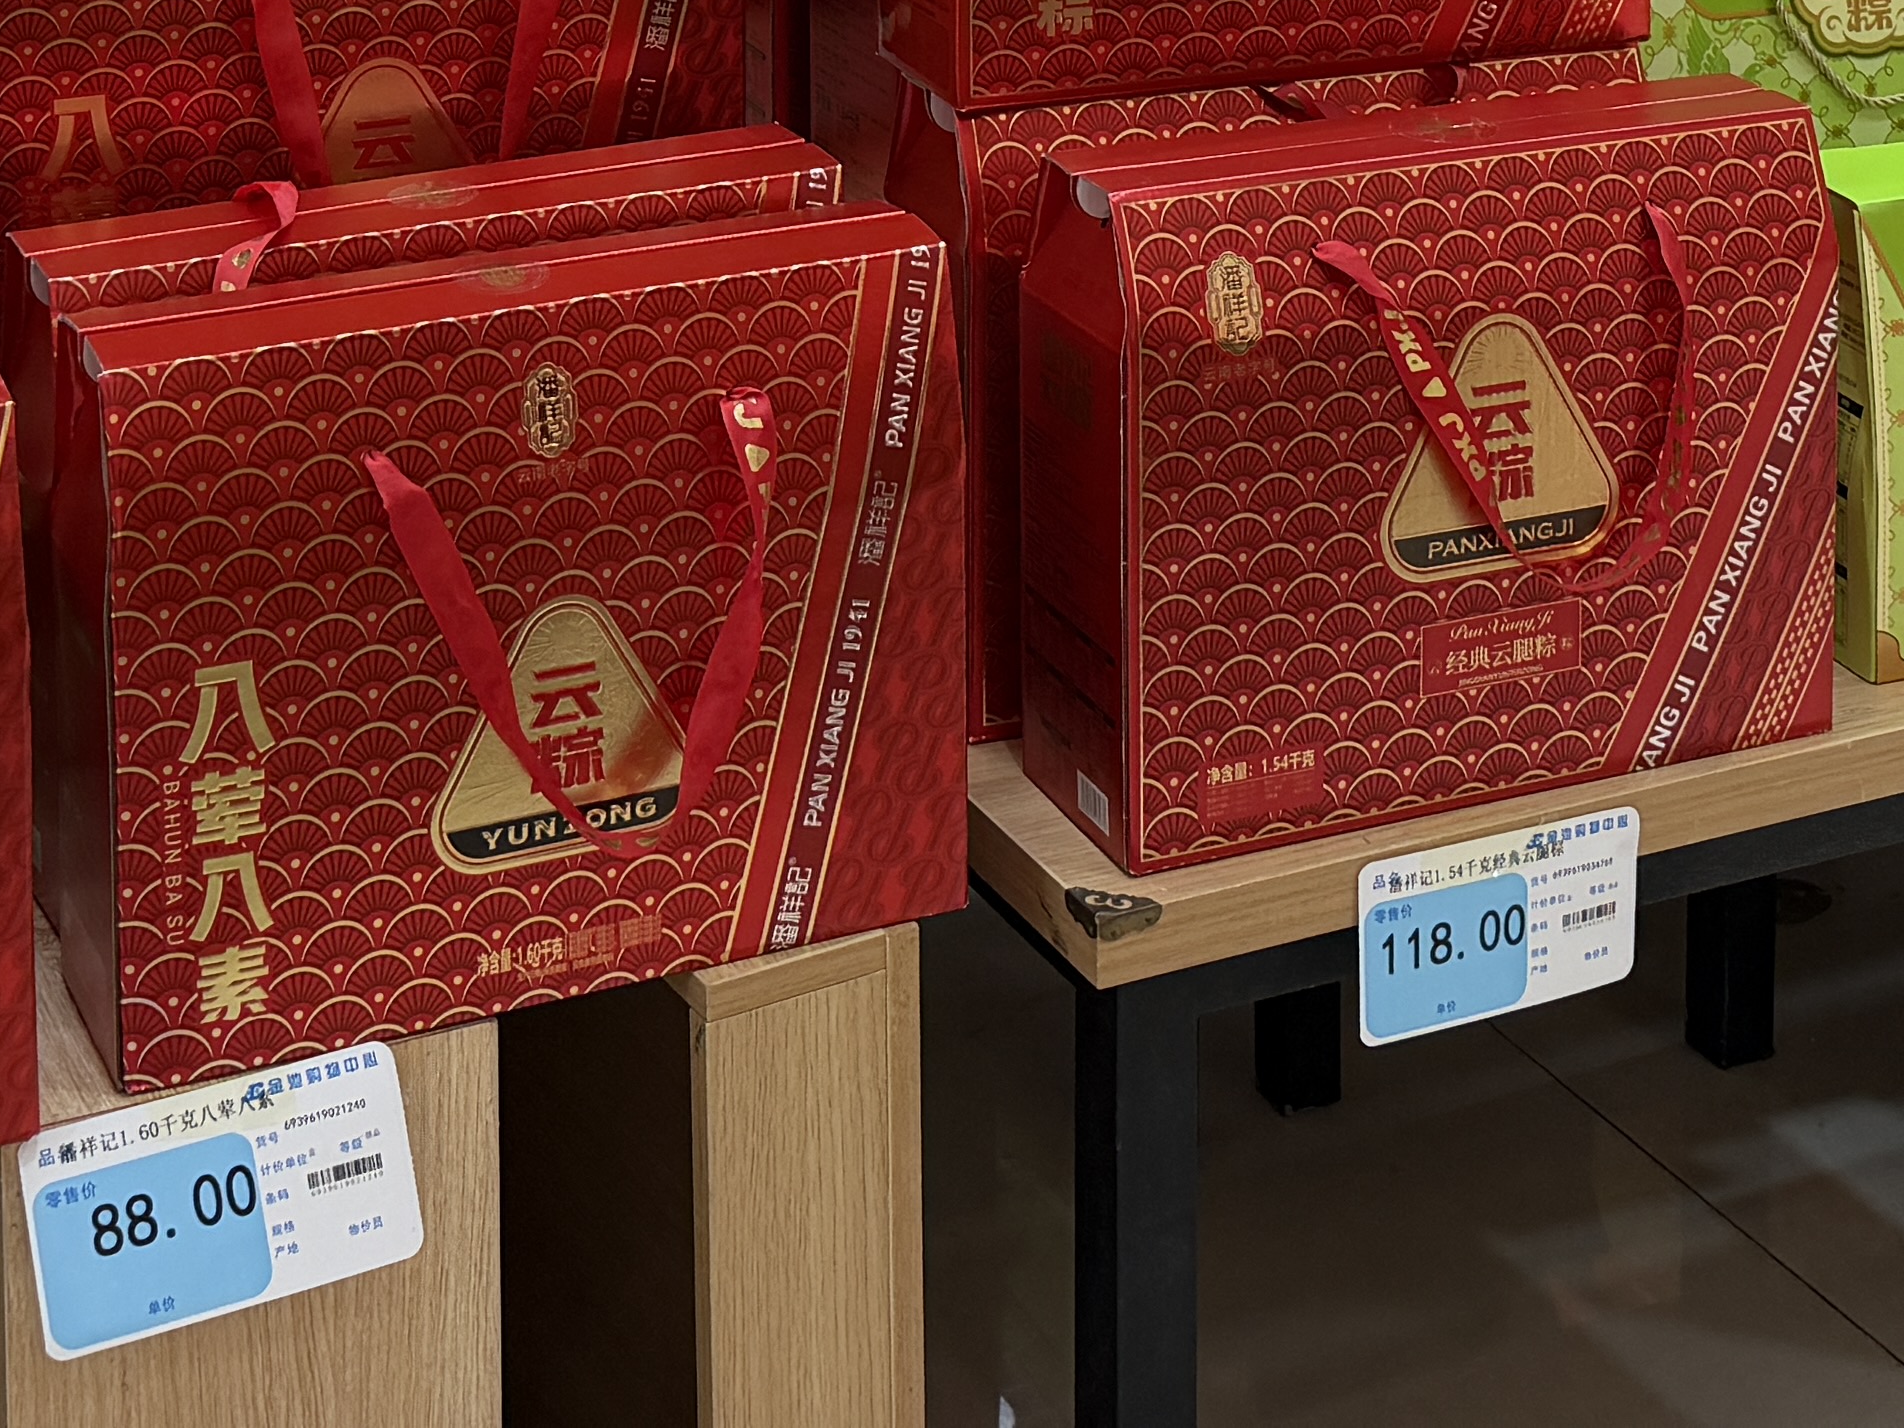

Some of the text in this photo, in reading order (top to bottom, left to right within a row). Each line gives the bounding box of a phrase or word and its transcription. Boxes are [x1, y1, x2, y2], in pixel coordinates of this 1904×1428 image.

[1693, 463, 1782, 653] PAN XIANG JI
[803, 597, 871, 829] PAN XIANG JI 1941
[1445, 634, 1557, 676] 经典云腿粽
[179, 662, 276, 1023] 八荤八素
[1382, 903, 1526, 976] 118.00
[91, 1164, 257, 1256] 88.00
